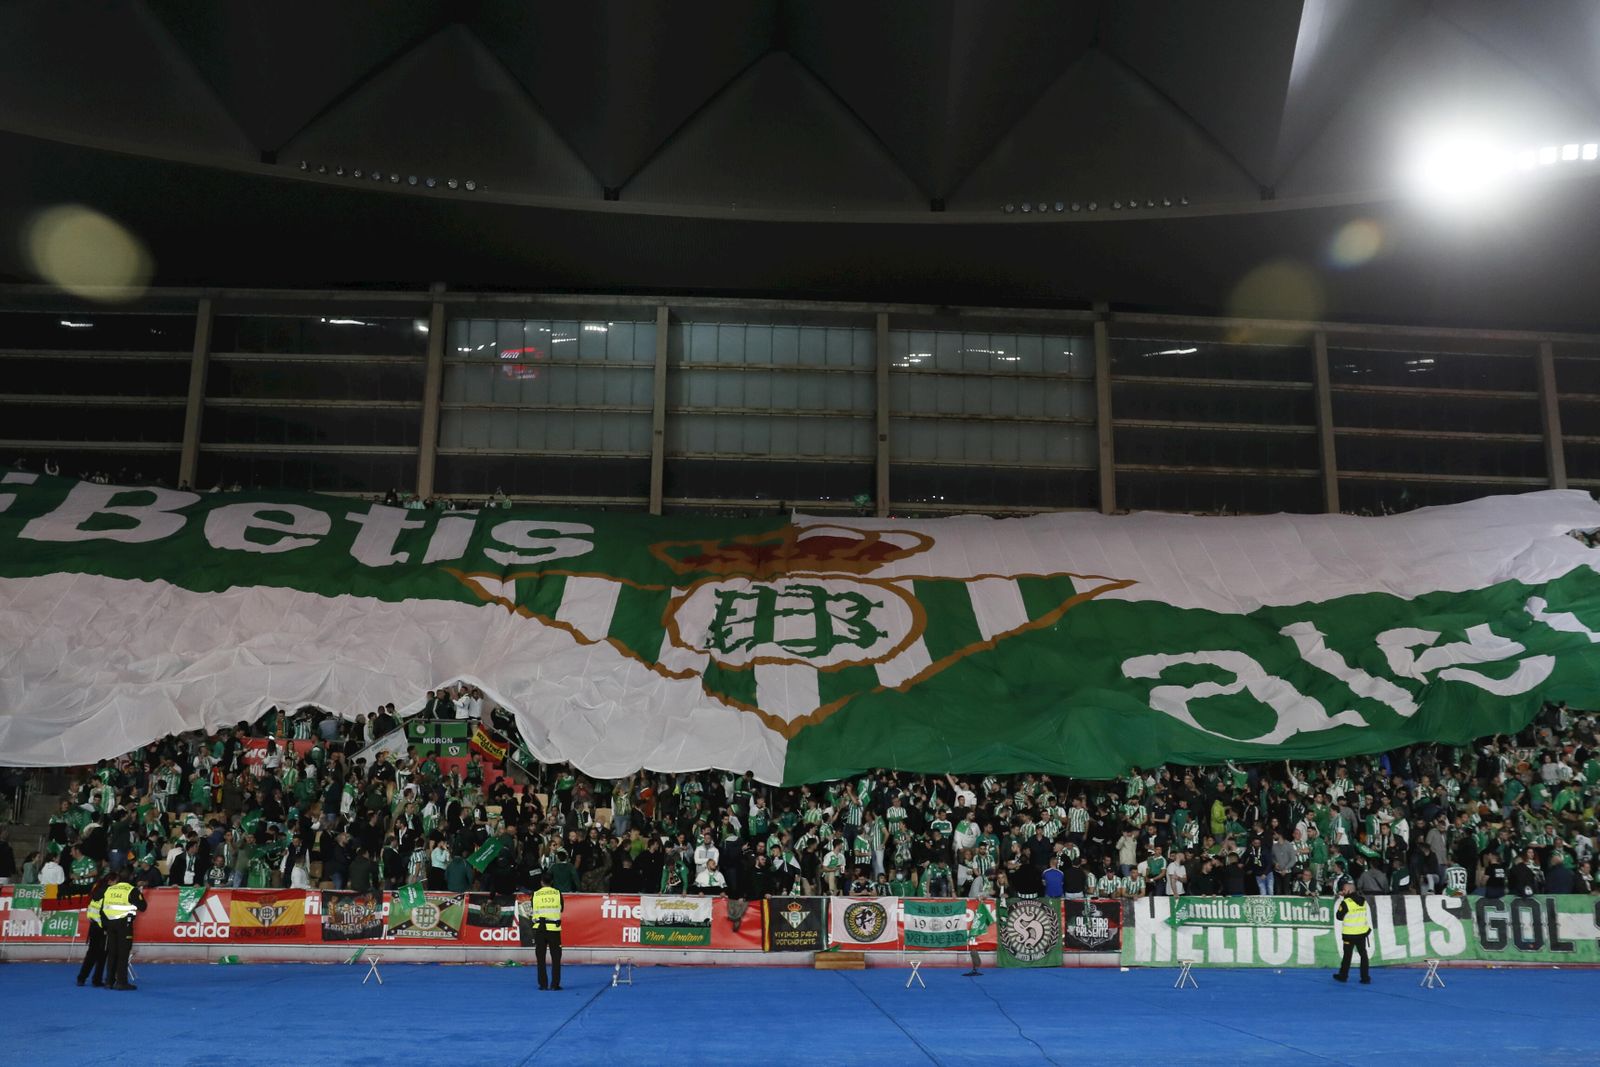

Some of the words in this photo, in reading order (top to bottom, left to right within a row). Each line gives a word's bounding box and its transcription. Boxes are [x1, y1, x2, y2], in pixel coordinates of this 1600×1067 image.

[1453, 872, 1466, 884] 13
[173, 922, 230, 938] adida
[1476, 898, 1576, 952] GOL
[480, 927, 520, 941] adid
